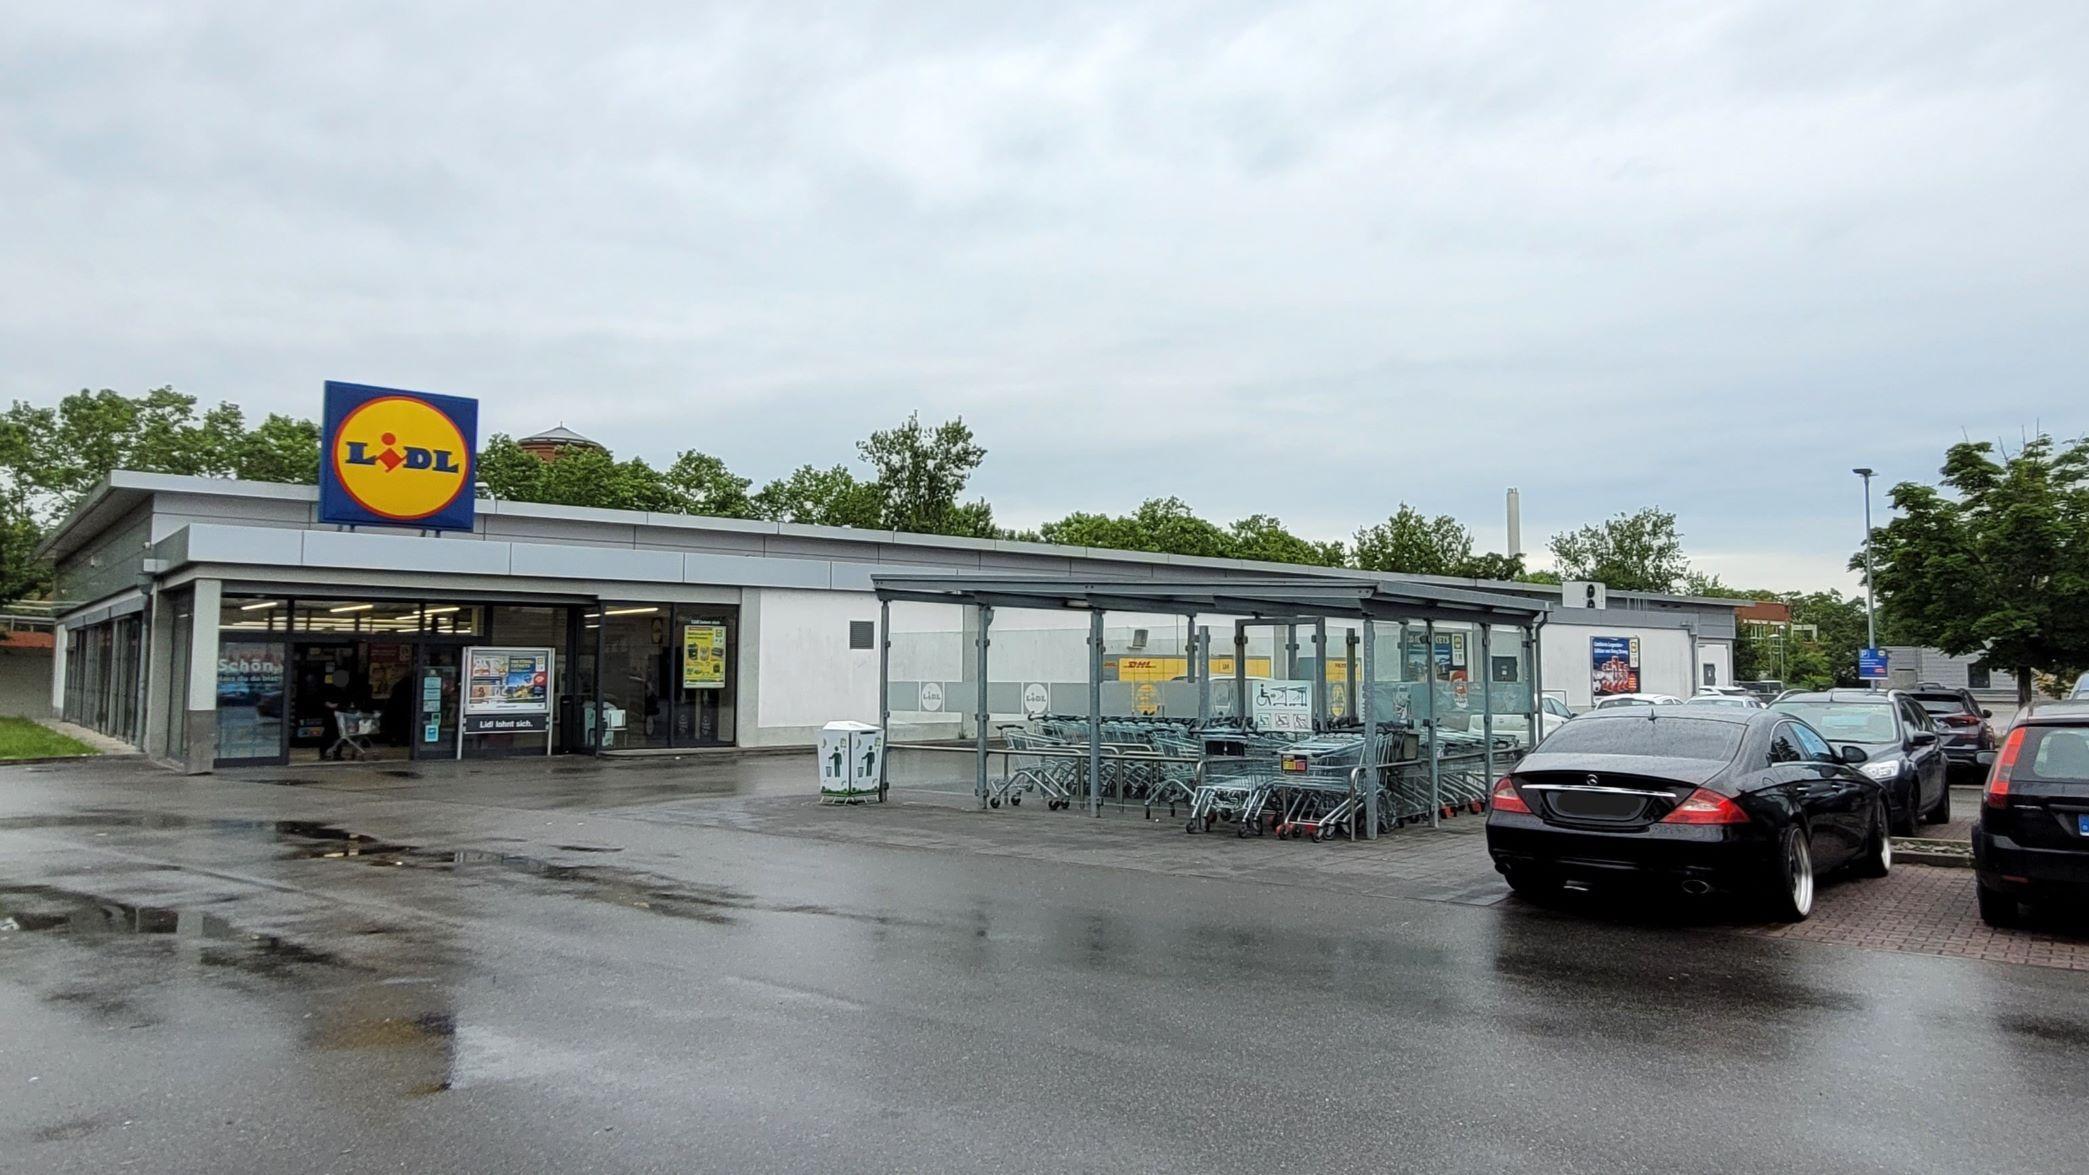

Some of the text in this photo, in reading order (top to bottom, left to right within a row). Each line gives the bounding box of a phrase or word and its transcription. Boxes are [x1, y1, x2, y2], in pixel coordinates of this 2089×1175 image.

[1127, 661, 1152, 669] DHL
[480, 720, 494, 728] Lidl
[495, 720, 515, 728] lohnt
